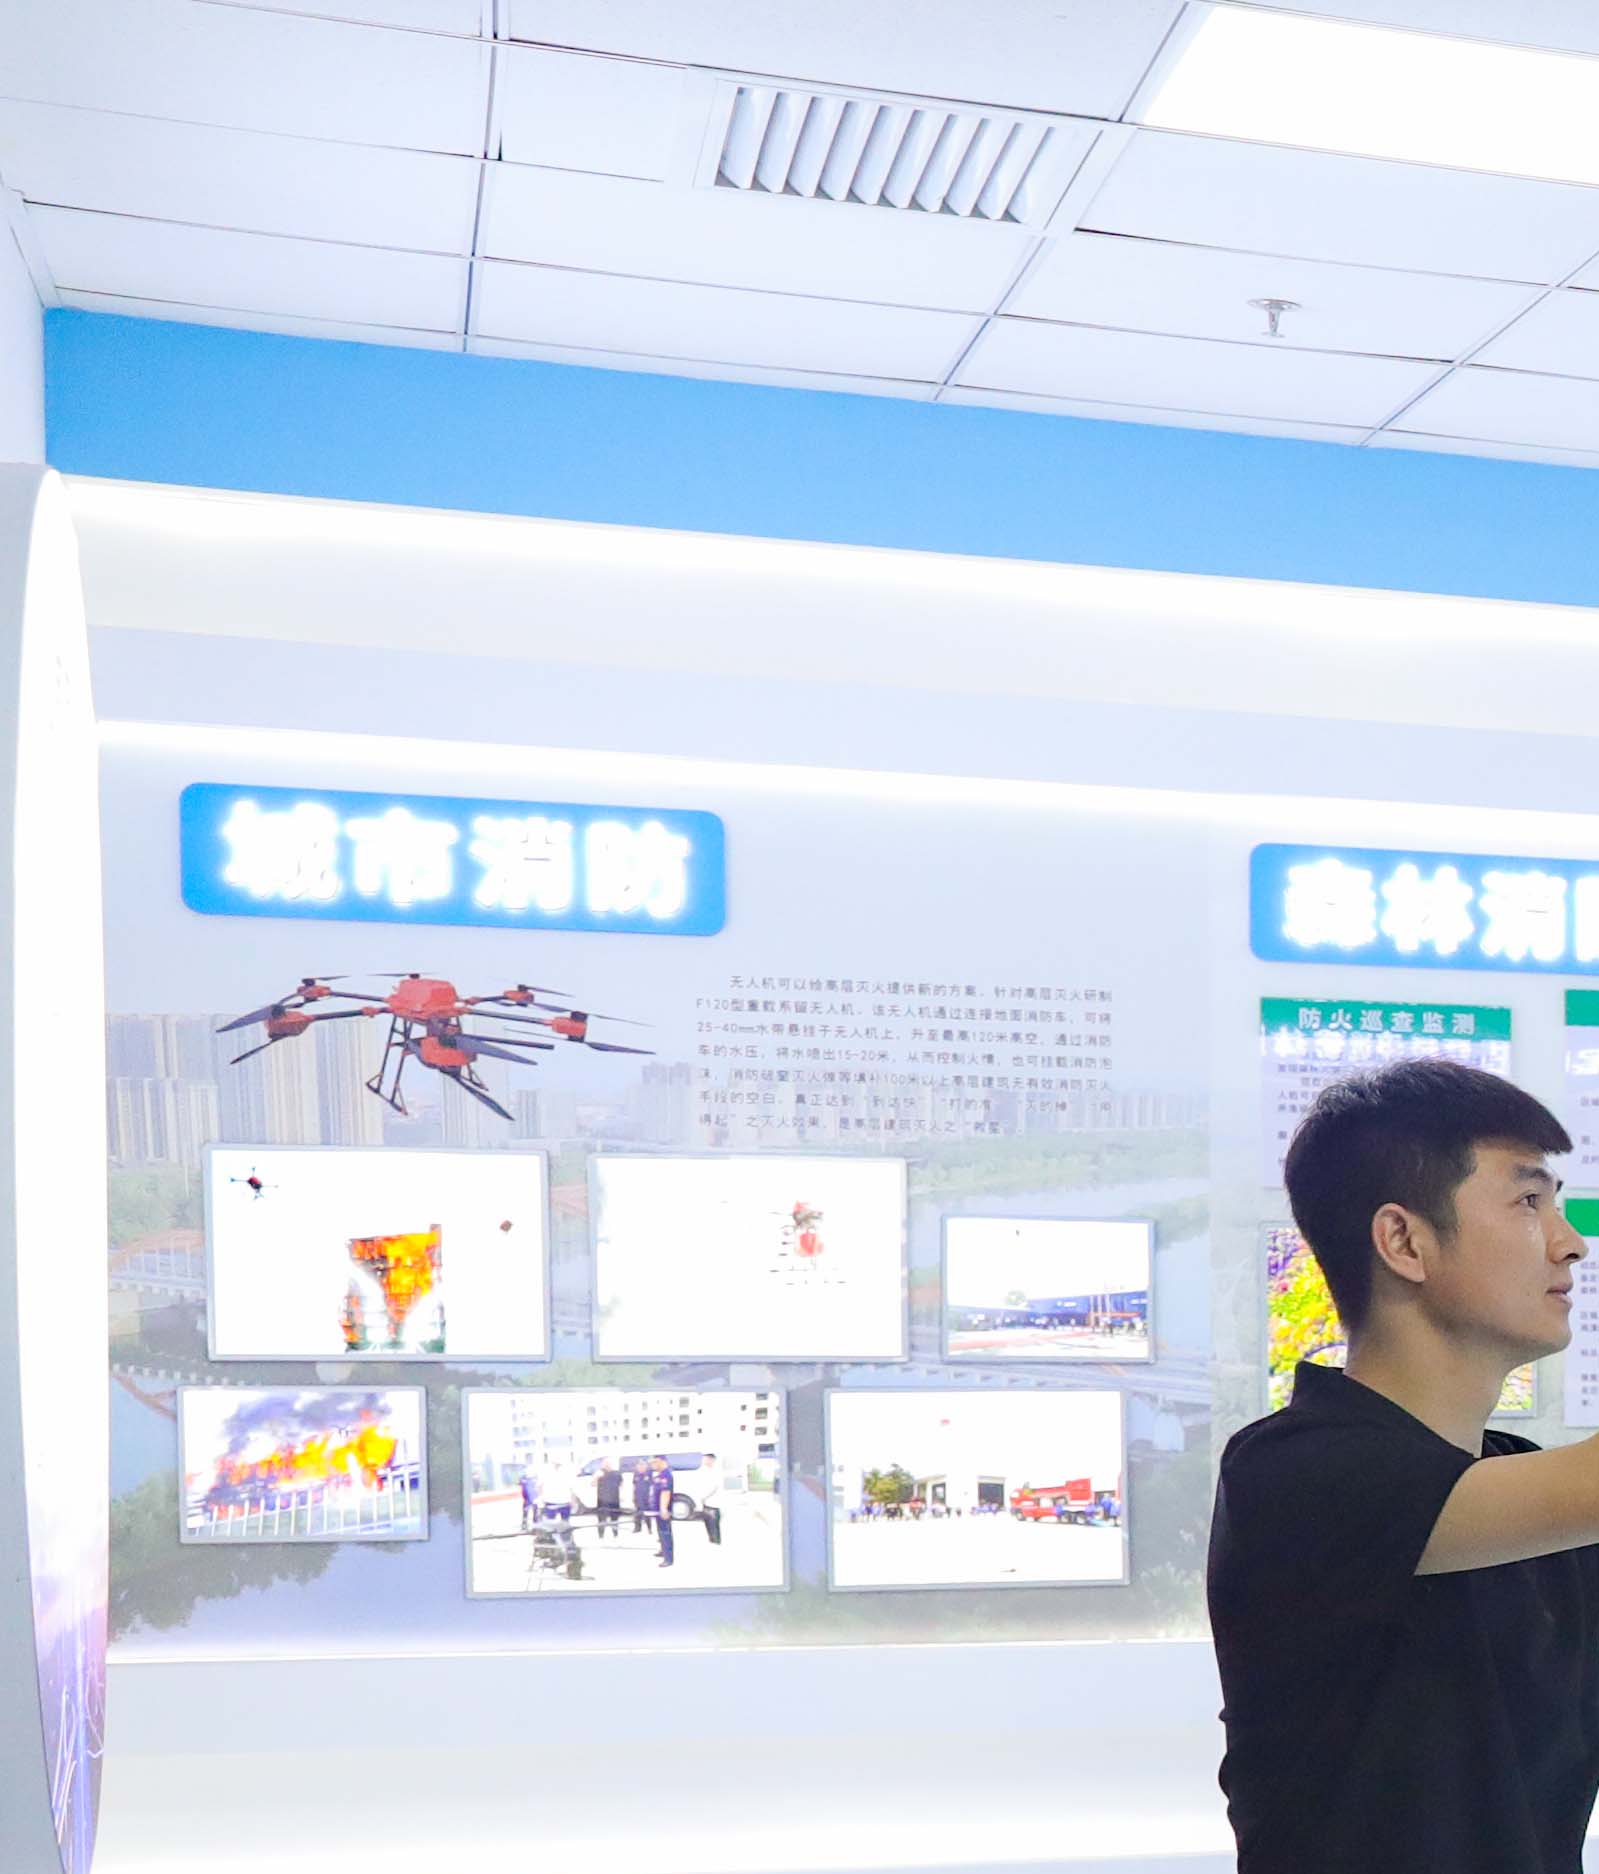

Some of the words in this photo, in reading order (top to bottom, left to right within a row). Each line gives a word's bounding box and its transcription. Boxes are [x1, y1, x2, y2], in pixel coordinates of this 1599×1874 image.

[220, 800, 694, 920] 城市消防
[1298, 1007, 1476, 1035] 防火巡查监测
